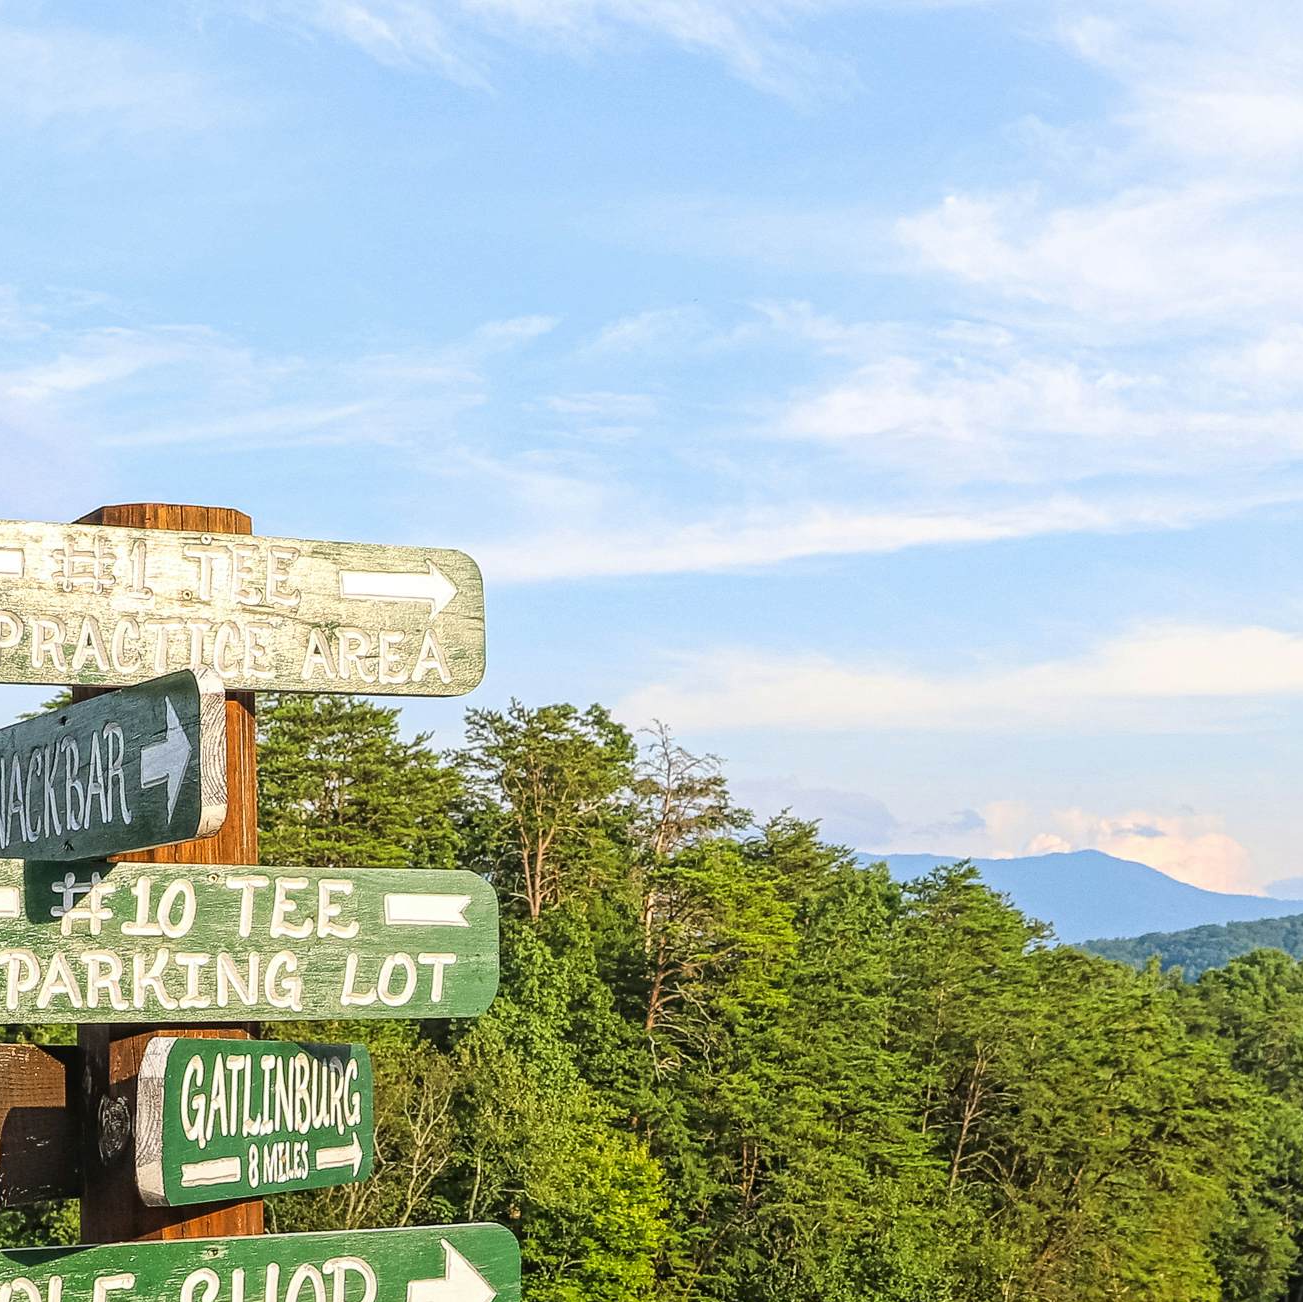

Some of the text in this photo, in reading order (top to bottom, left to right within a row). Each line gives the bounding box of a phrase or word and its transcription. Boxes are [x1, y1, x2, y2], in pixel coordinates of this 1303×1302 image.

[52, 535, 301, 607] #1 TEE
[300, 627, 453, 685] AREA
[50, 871, 360, 939] #10 TEE
[340, 951, 457, 1006] LOT
[180, 1051, 362, 1149] GATLINBURG
[247, 1139, 310, 1189] 8 MILES
